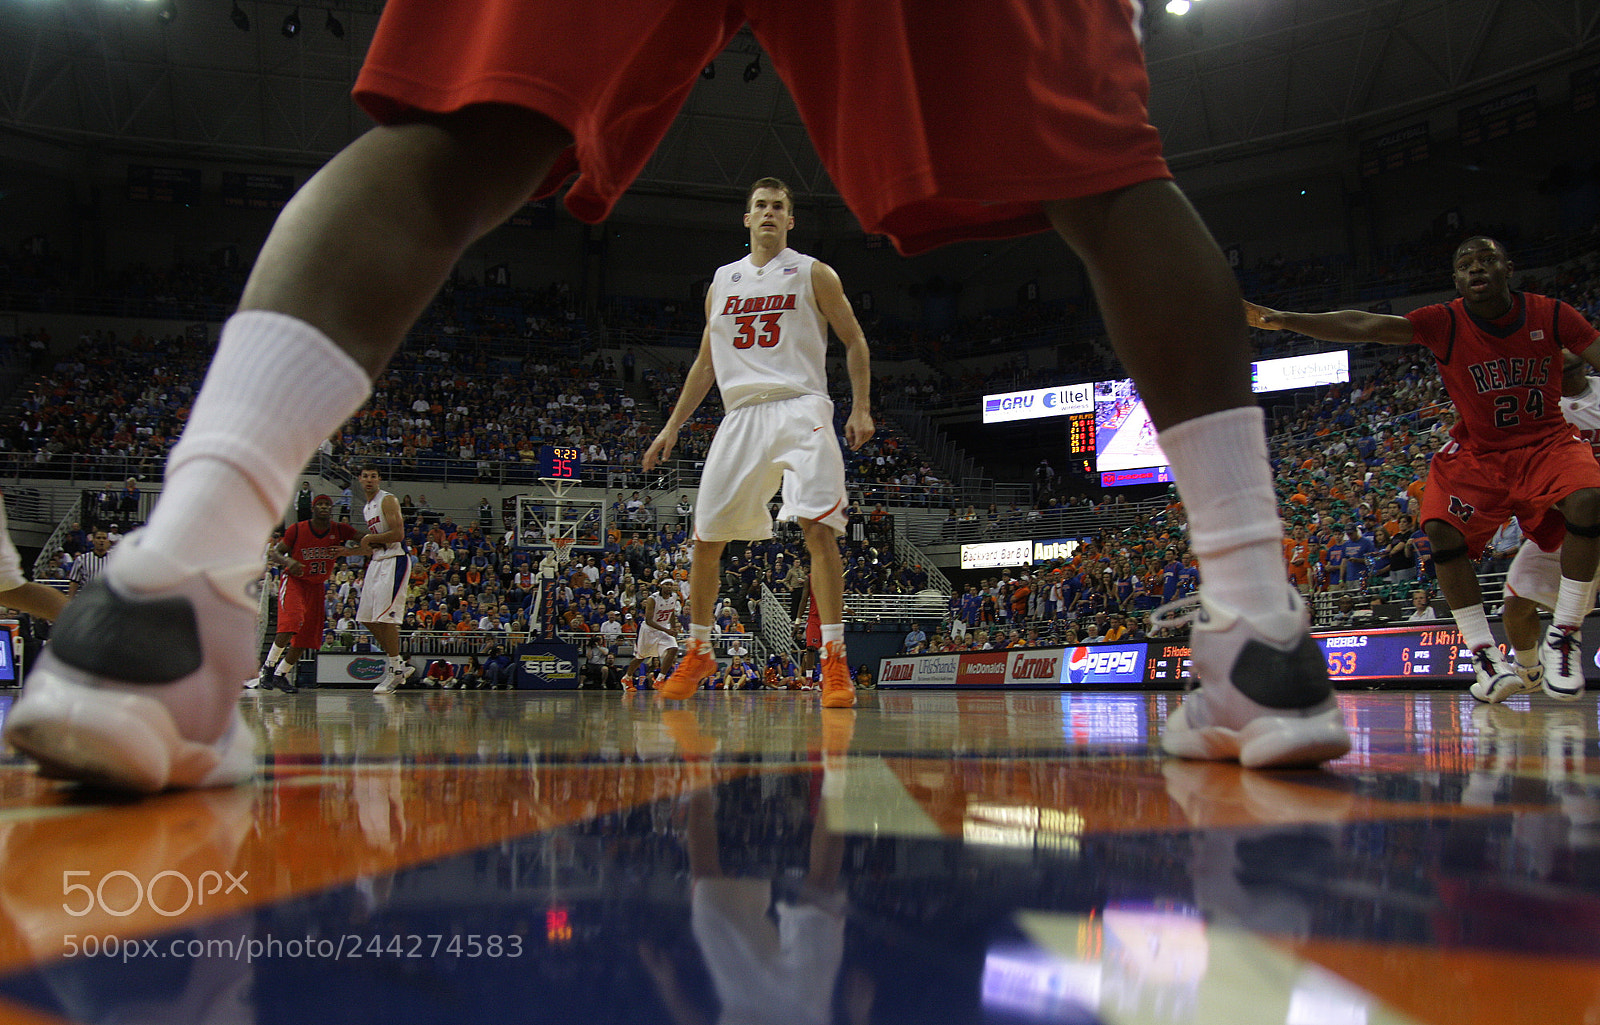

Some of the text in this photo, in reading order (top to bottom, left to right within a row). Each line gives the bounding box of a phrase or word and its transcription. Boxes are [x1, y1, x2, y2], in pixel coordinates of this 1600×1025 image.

[721, 294, 796, 315] FLORIDA
[733, 312, 783, 349] 33
[1468, 357, 1552, 394] REBELS
[1002, 395, 1034, 410] GRU
[1494, 388, 1544, 428] 24
[554, 449, 577, 459] 9:23
[552, 459, 572, 477] 35
[963, 551, 998, 562] Backyard
[311, 561, 327, 574] 31
[657, 613, 668, 621] 23
[1326, 636, 1367, 648] REBELS
[1420, 632, 1433, 646] 21
[1163, 646, 1171, 657] 15
[1402, 648, 1410, 661] 6
[1449, 646, 1458, 660] 3
[525, 660, 573, 674] SEC
[966, 662, 1005, 674] McDonald's
[1012, 653, 1057, 680] GATORS
[1084, 651, 1138, 674] PEPSI
[1148, 659, 1156, 669] 11
[1176, 658, 1181, 668] 1
[1327, 651, 1357, 675] 53
[1403, 661, 1474, 675] 0 BLK 1 STL
[882, 661, 914, 681] FLORIDA
[1150, 669, 1156, 680] 0
[1175, 669, 1181, 679] 3
